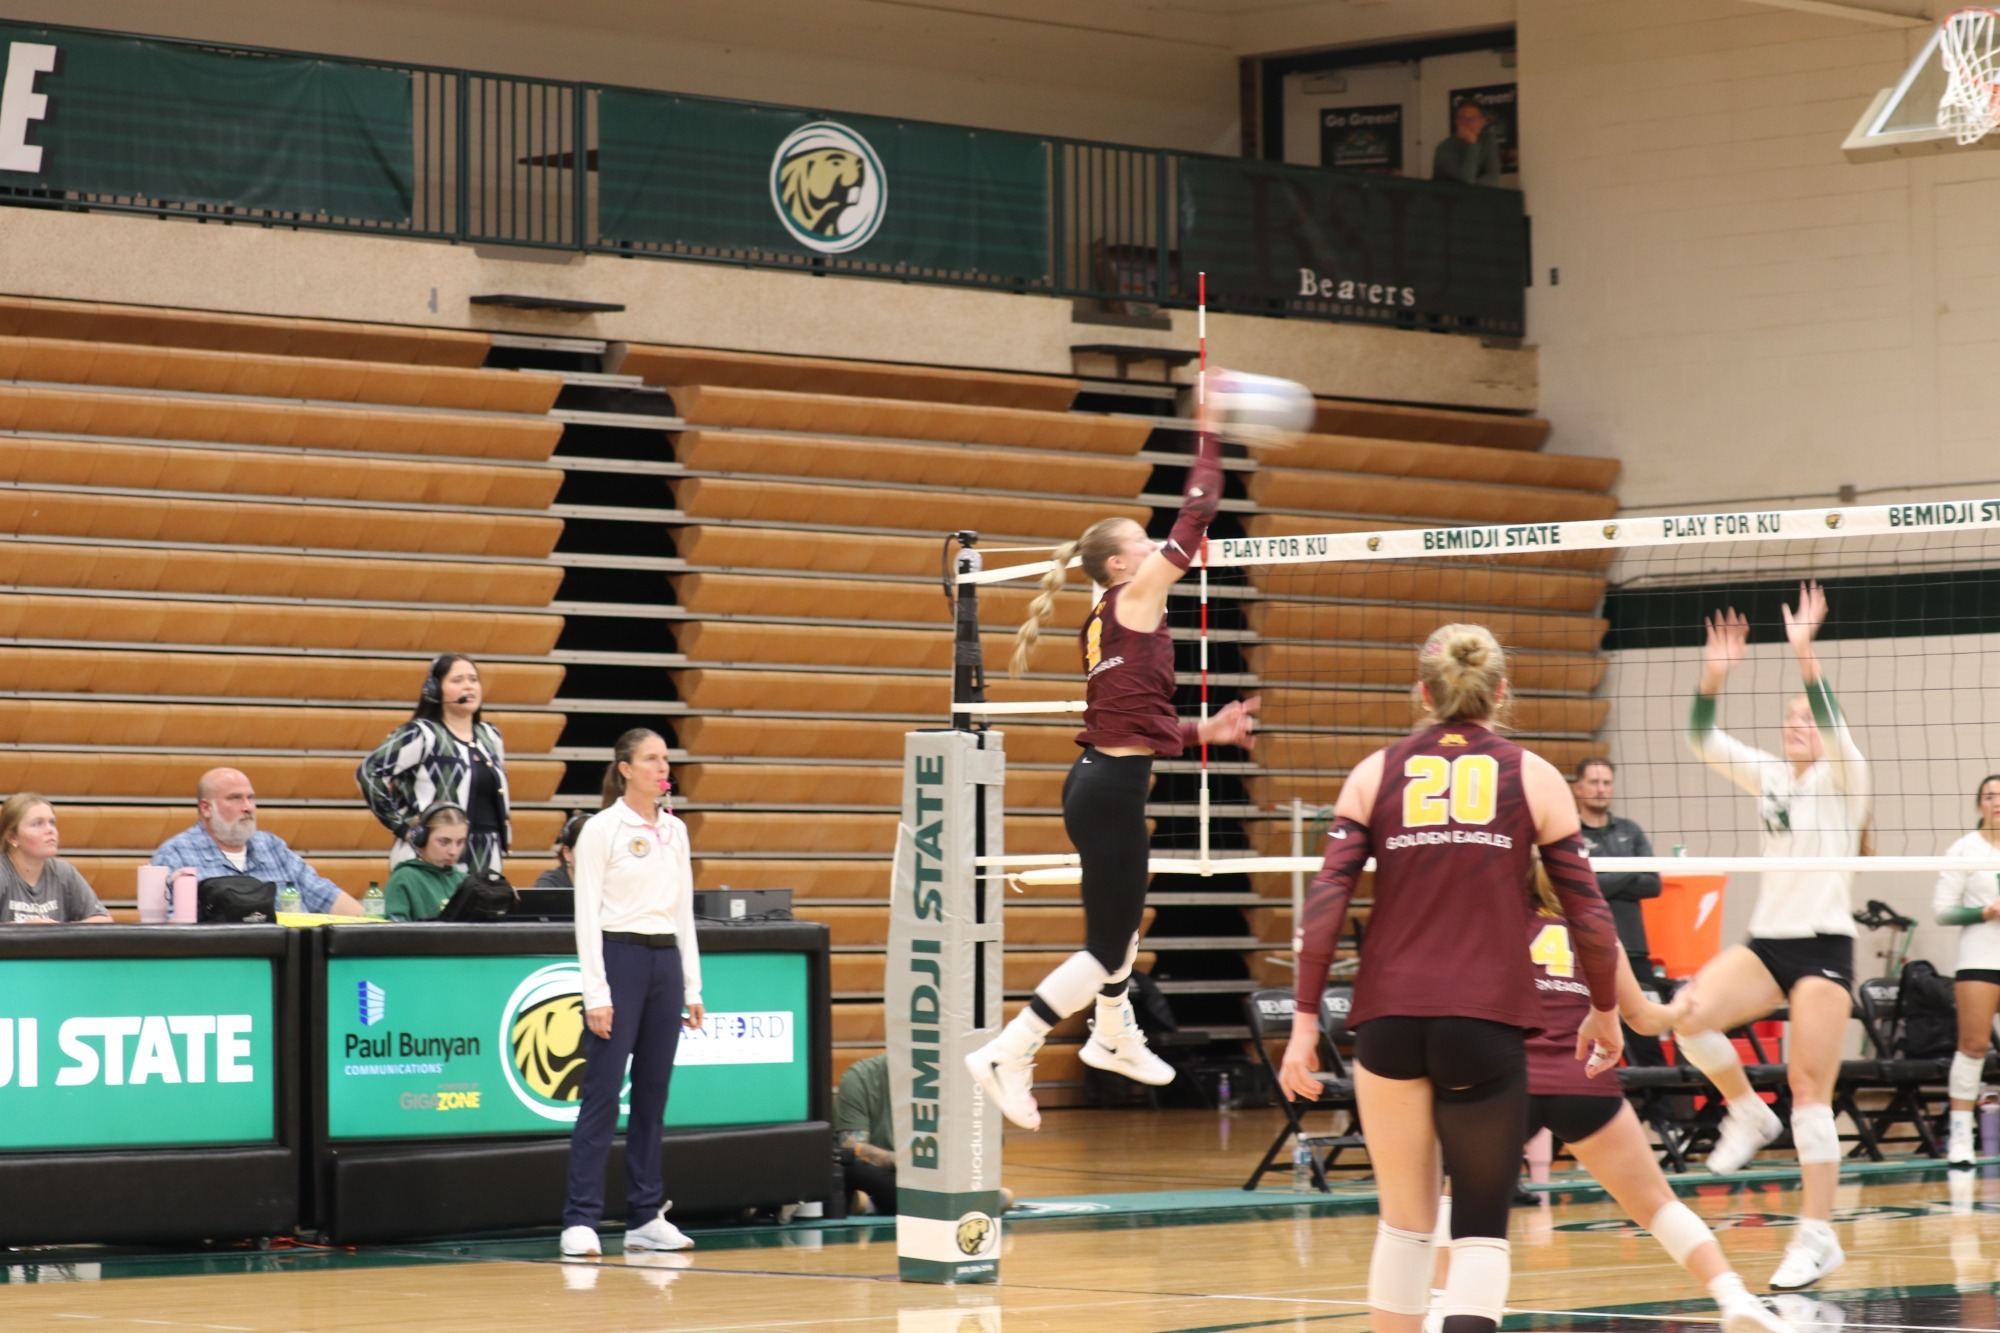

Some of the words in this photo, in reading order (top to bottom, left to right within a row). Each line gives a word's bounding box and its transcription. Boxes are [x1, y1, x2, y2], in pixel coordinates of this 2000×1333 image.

[1324, 114, 1346, 128] Go
[1348, 110, 1400, 126] Green!
[1299, 268, 1416, 307] Beavers
[1663, 516, 1708, 538] PLAY
[1715, 515, 1750, 535] FOR
[1757, 514, 1781, 533] KU
[1889, 503, 1974, 527] BEMIDJI
[1223, 539, 1263, 558] PLAY
[1268, 538, 1300, 557] FOR
[1307, 537, 1328, 556] KU
[1423, 527, 1499, 551] BEMIDJI
[1505, 525, 1561, 547] STATE
[1402, 754, 1499, 828] 20
[914, 755, 945, 923] STATE
[1385, 831, 1452, 850] GOLDEN
[1452, 830, 1513, 849] EAGLES
[1529, 924, 1575, 978] 4
[55, 1014, 254, 1087] STATE
[345, 1031, 392, 1058] Paul
[399, 1032, 481, 1063] Bunyan
[910, 939, 943, 1170] BEMIDJI
[344, 1063, 443, 1075] COMMUNICATIONS
[970, 1120, 984, 1192] imports
